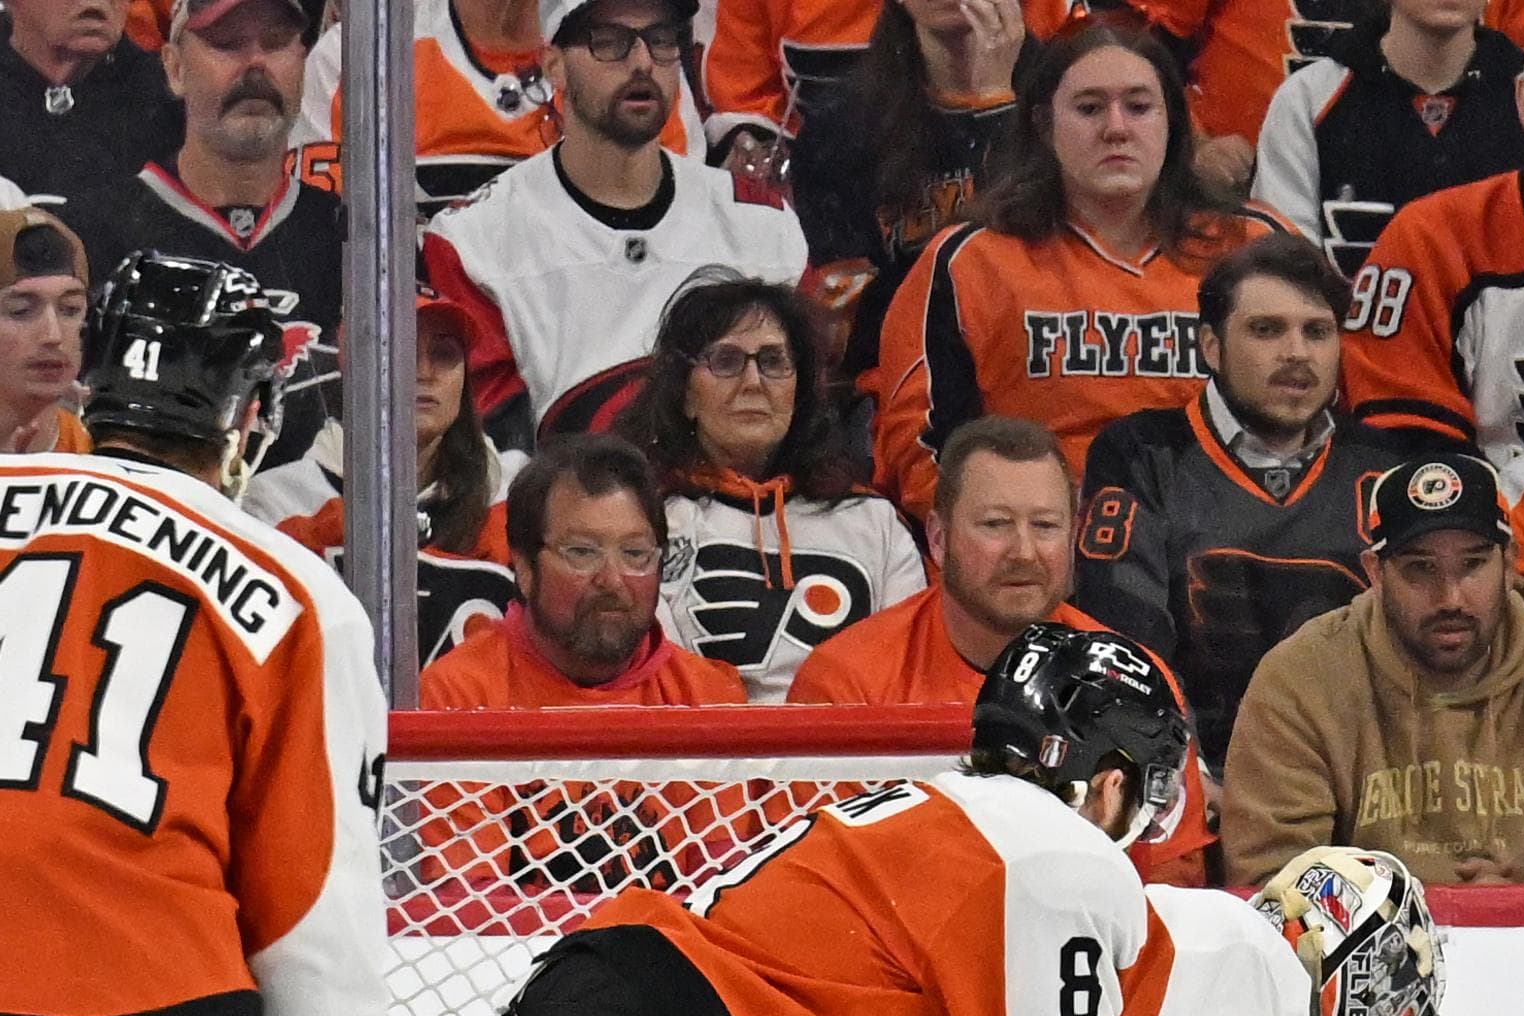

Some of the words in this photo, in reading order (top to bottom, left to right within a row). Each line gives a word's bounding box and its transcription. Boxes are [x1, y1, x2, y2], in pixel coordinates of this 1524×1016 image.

[123, 340, 160, 382] 41
[1014, 652, 1039, 682] 8
[0, 551, 200, 837] 41
